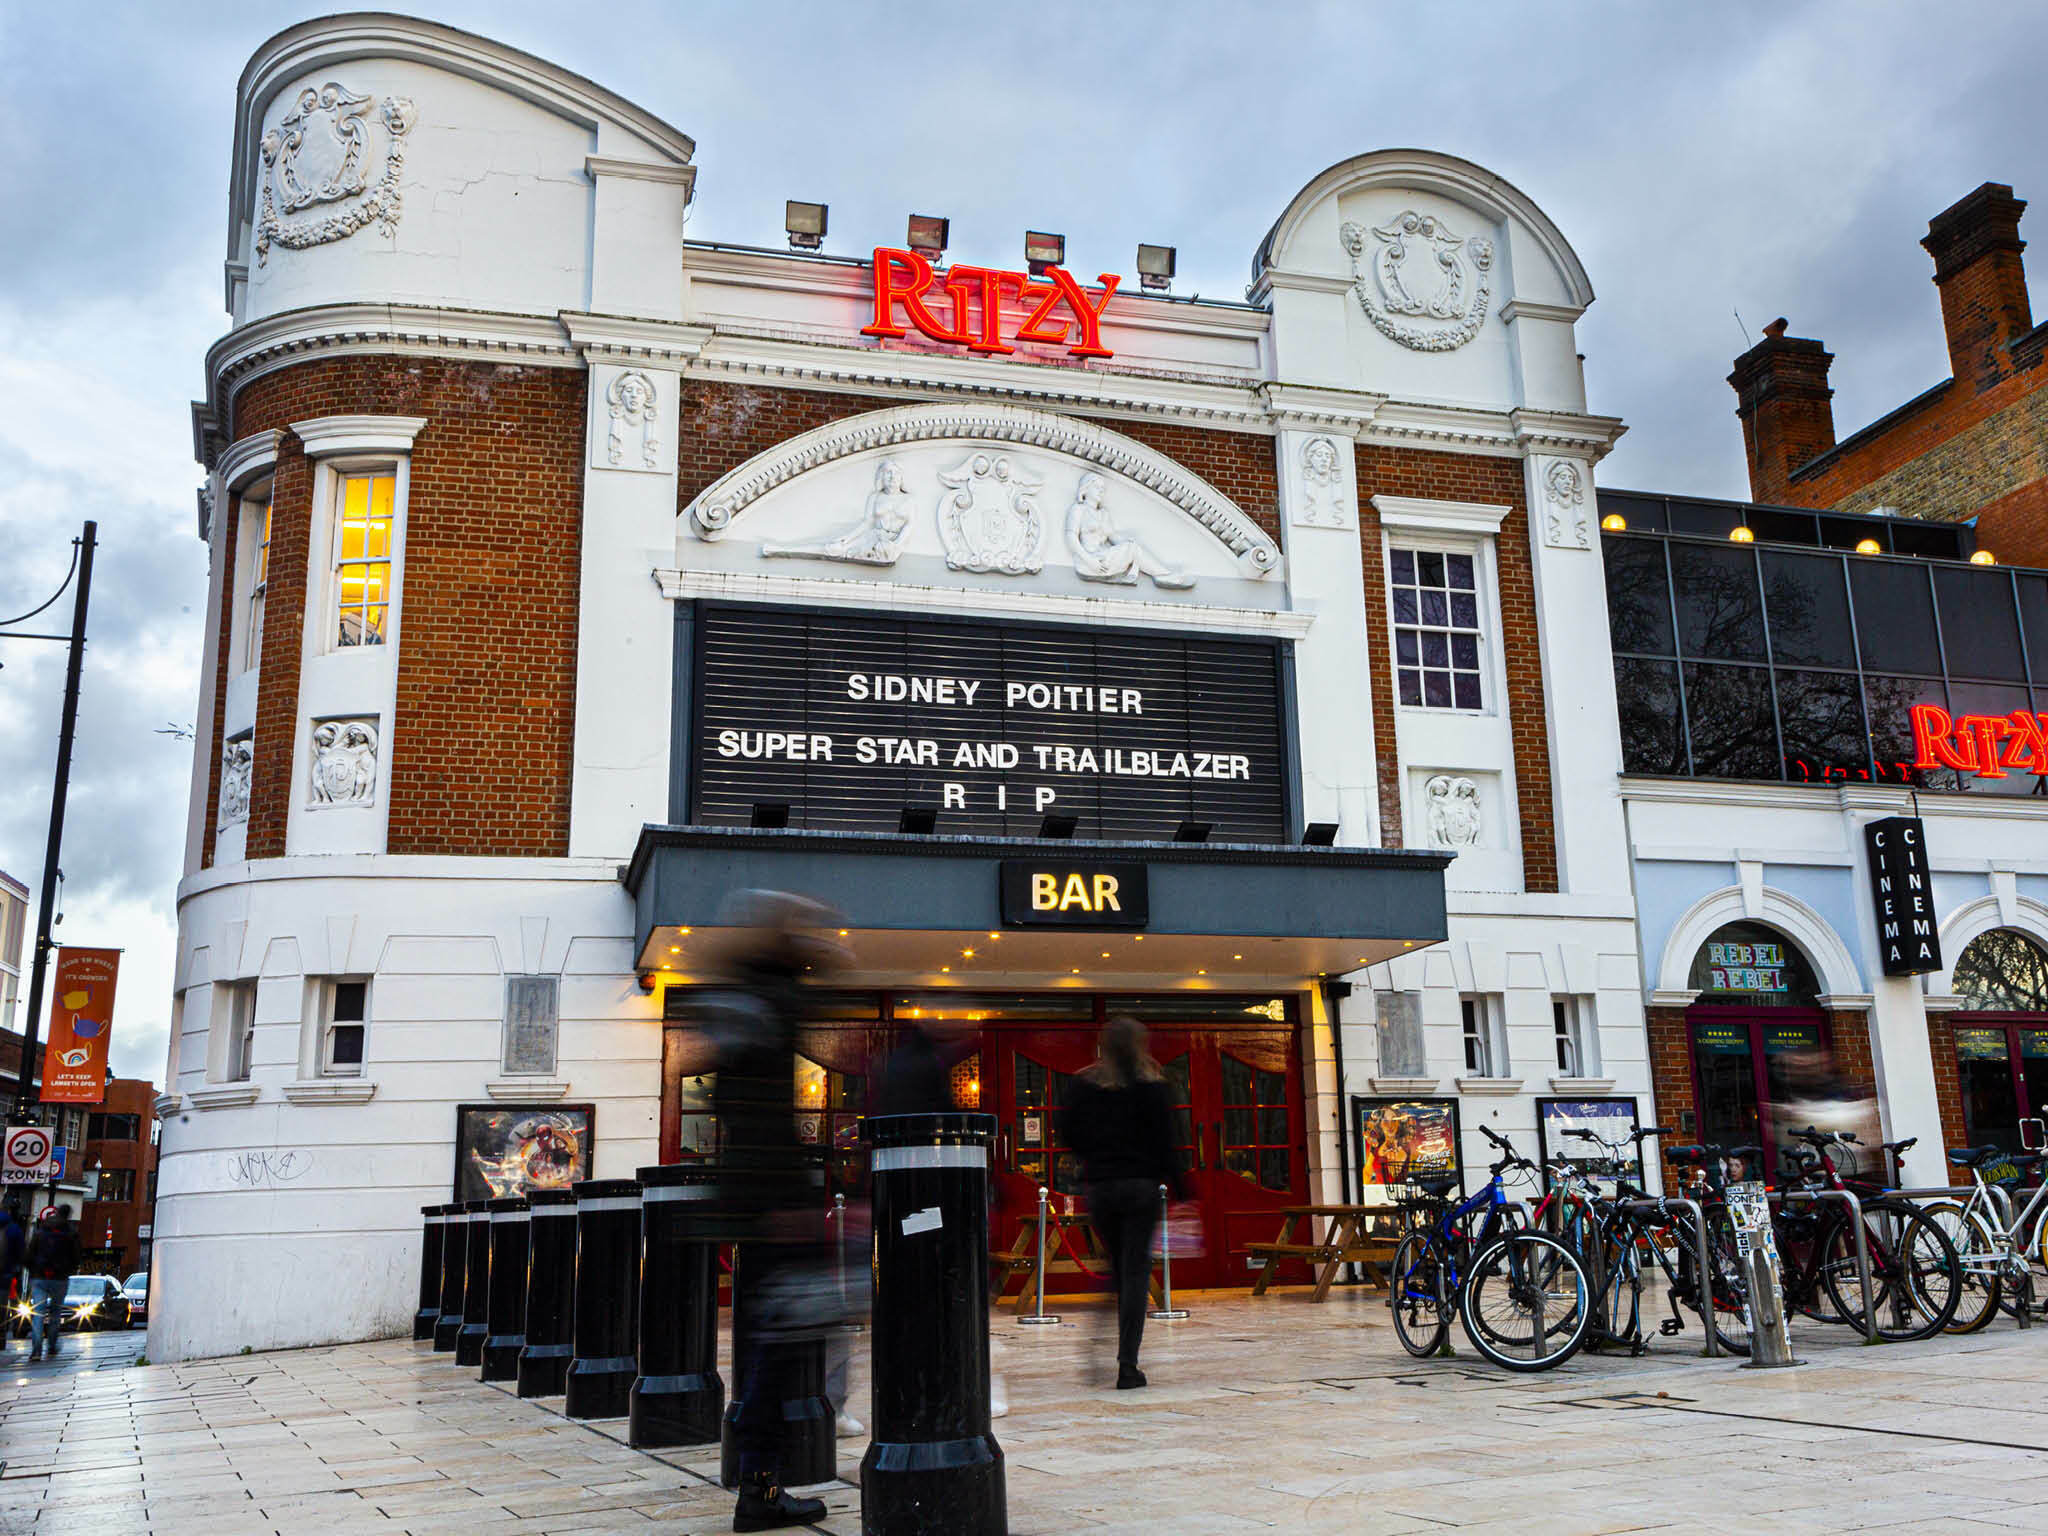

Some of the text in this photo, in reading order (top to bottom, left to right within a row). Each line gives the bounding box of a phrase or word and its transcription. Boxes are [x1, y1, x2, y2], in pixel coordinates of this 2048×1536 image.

[847, 674, 1143, 715] SIDNEY POITIER
[717, 729, 1251, 780] SUPER STAR AND TRAILBLAZER
[943, 783, 1057, 813] R I P
[1031, 873, 1122, 912] BAR
[1875, 831, 1901, 962] CINEMA
[1903, 828, 1933, 960] CINEMA
[1708, 943, 1785, 967] REBEL
[1711, 968, 1788, 992] REBEL
[15, 1141, 44, 1156] 20
[7, 1169, 45, 1180] ZONE
